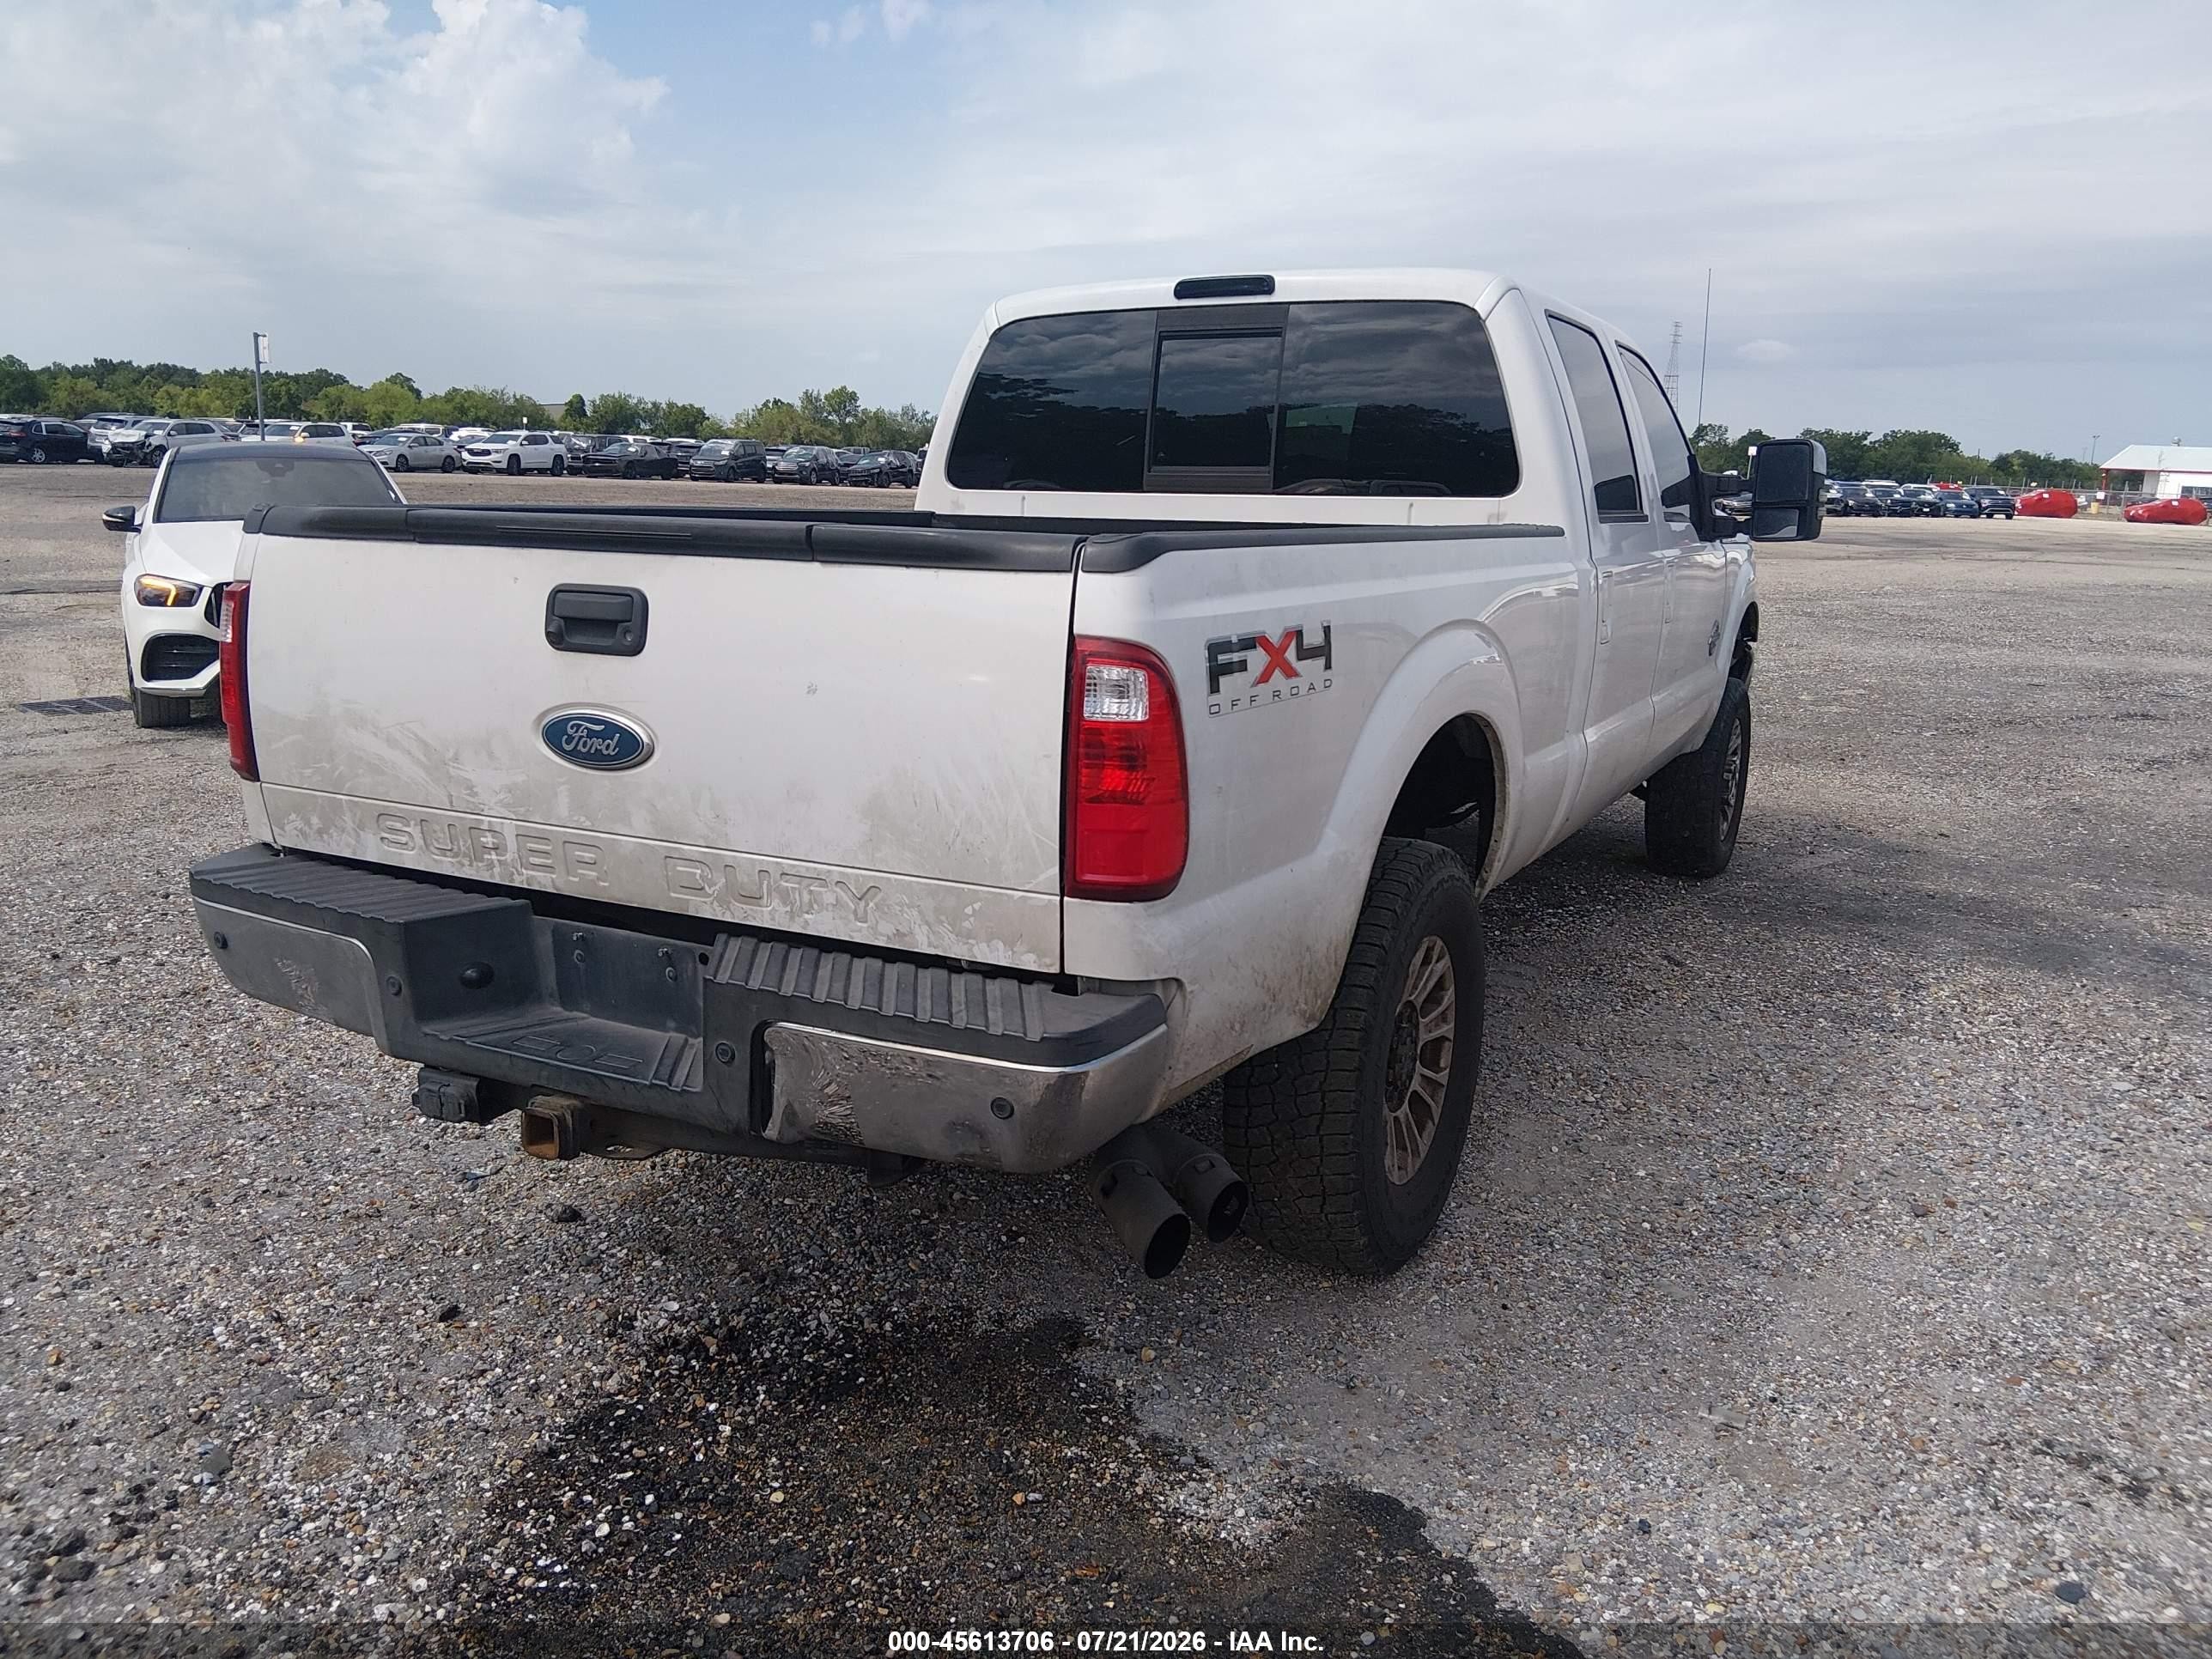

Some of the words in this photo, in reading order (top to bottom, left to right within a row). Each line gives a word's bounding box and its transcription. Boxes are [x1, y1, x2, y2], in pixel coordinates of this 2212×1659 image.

[1206, 621, 1332, 696] FX4
[1208, 695, 1260, 715] OFF
[1272, 678, 1333, 701] ROAD
[562, 720, 620, 756] Ford
[377, 813, 610, 886] SUPER
[665, 856, 882, 925] DUTY
